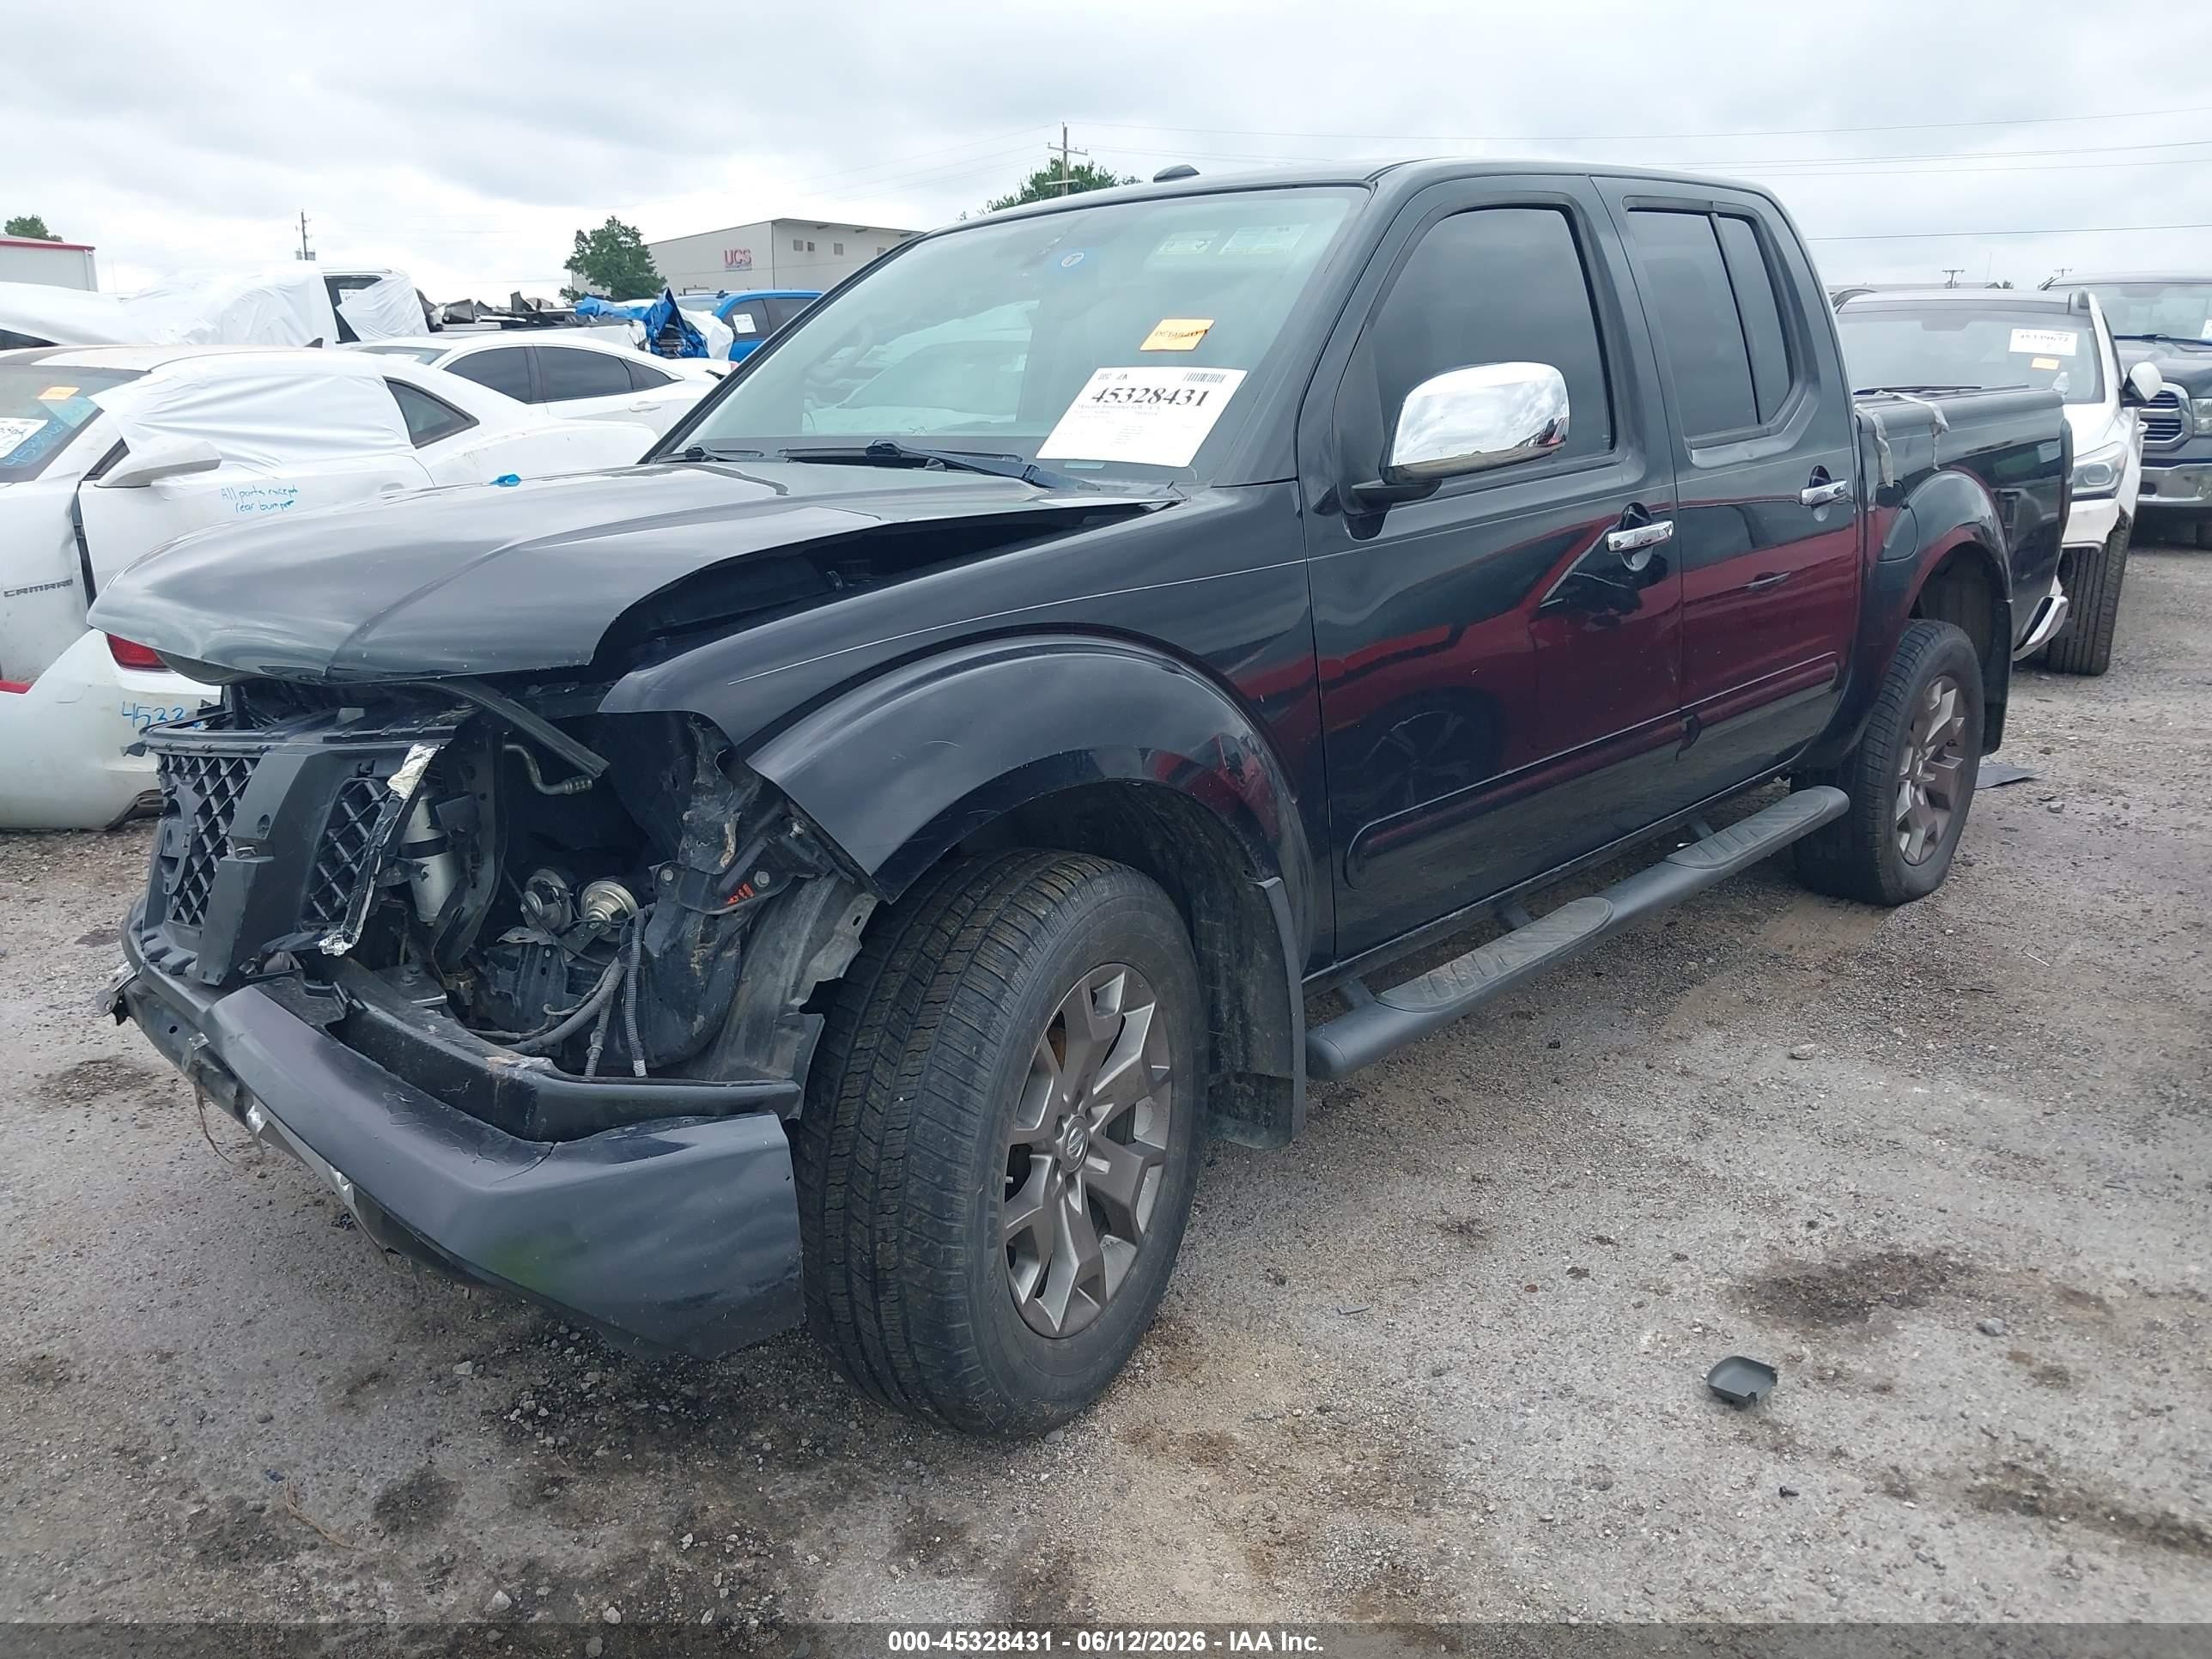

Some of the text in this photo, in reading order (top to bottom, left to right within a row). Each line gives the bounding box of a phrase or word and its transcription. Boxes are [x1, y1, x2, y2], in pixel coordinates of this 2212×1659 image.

[724, 248, 752, 265] UCS
[1091, 386, 1210, 407] 45328431
[221, 487, 237, 501] All
